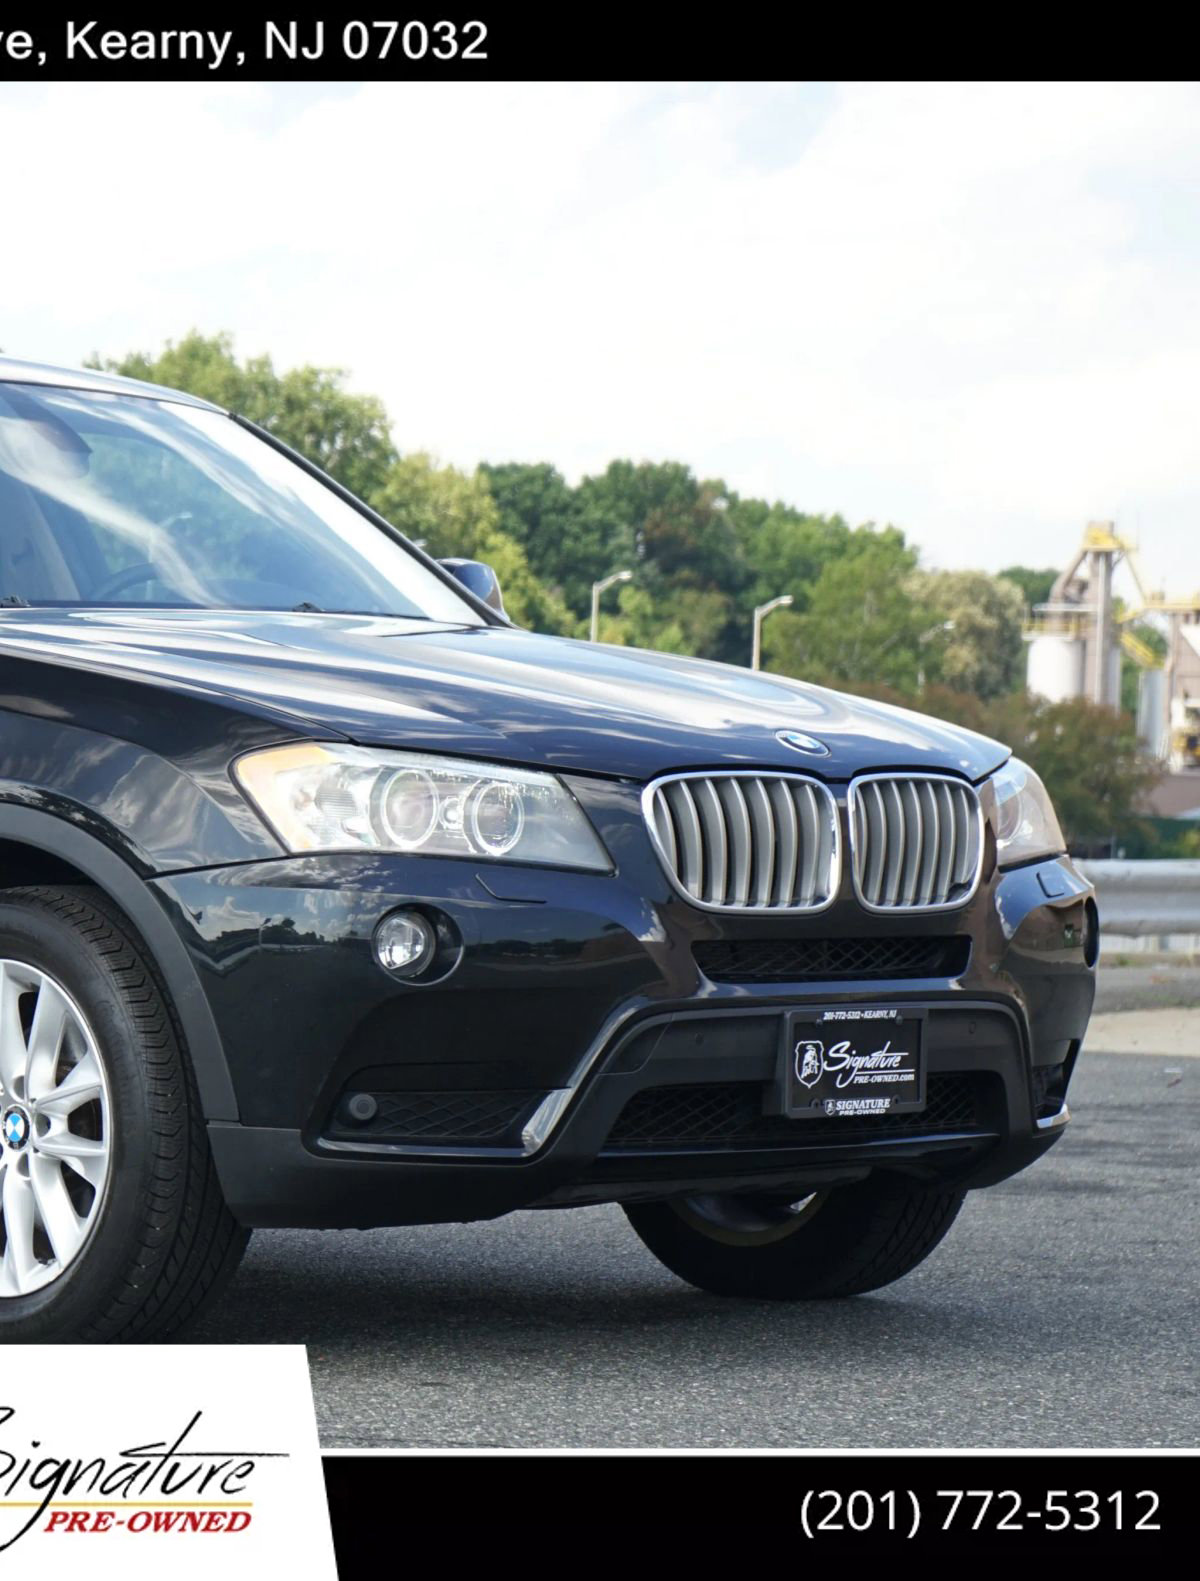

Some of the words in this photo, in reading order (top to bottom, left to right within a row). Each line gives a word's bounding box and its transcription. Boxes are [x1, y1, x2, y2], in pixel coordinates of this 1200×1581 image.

[824, 1041, 909, 1089] Signature
[836, 1098, 890, 1111] SIGNATURE
[839, 1108, 886, 1116] PRE-OWNED
